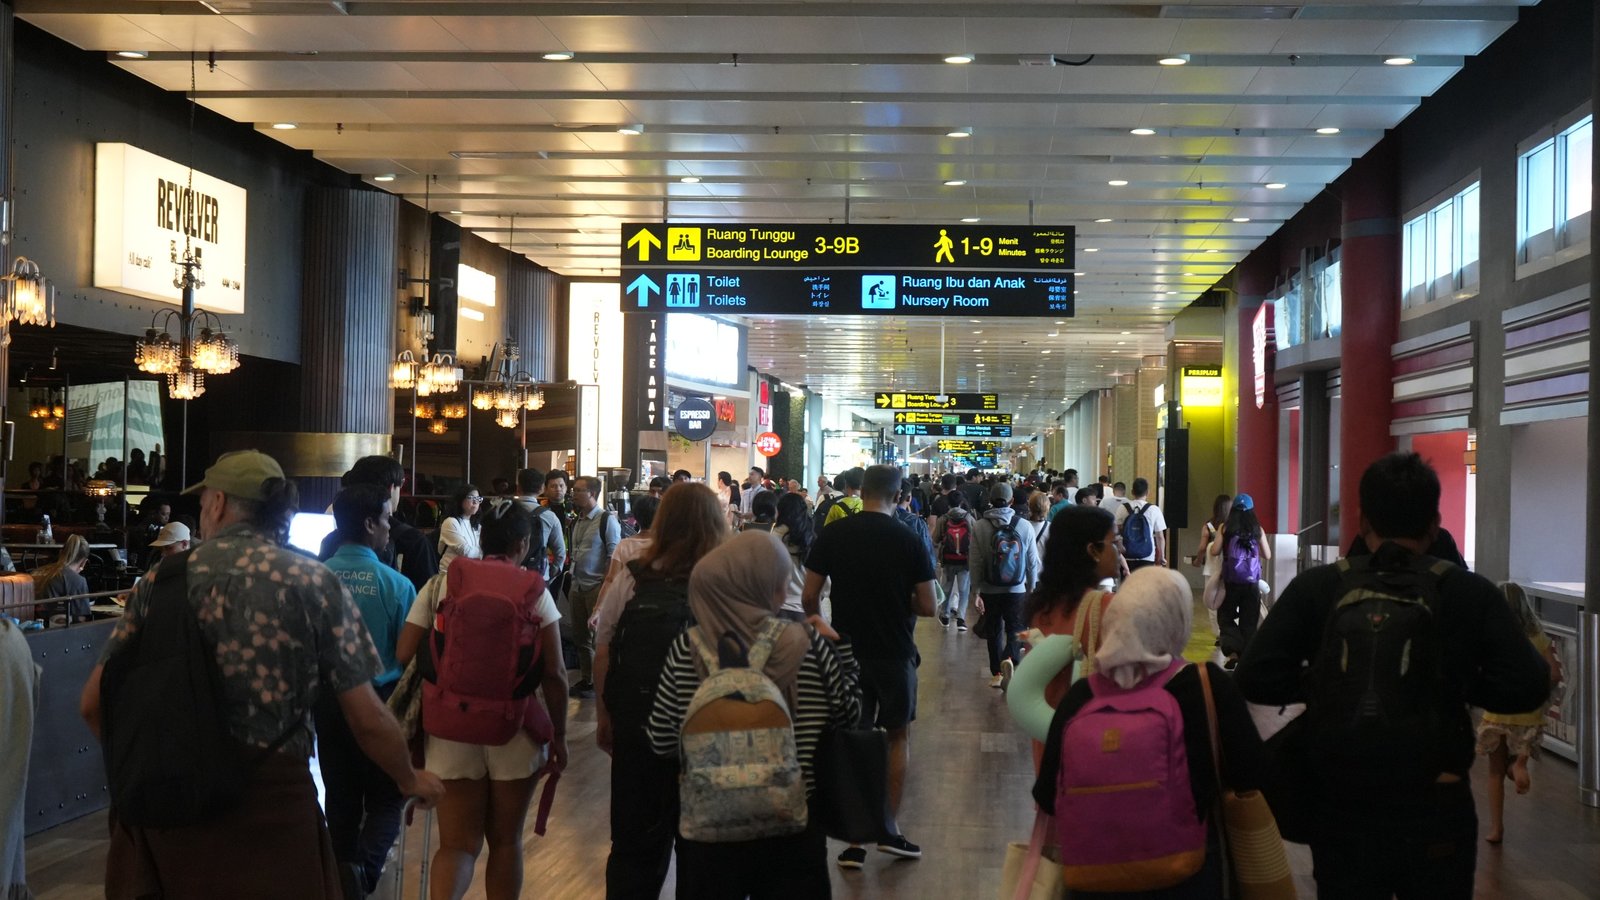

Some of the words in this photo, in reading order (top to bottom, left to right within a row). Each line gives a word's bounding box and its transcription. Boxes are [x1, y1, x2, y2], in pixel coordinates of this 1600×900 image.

[157, 178, 219, 245] REVOLVER
[707, 228, 747, 243] Ruang
[749, 228, 796, 243] Tunggu
[998, 237, 1019, 245] Menit
[814, 236, 860, 254] 3-9B
[960, 237, 994, 256] 1-9
[998, 248, 1027, 257] Minutes
[706, 246, 761, 262] Boarding
[763, 247, 809, 262] Lounge
[706, 275, 740, 288] Toilet
[902, 275, 943, 291] Ruang
[945, 276, 965, 288] Ibu
[970, 276, 991, 289] dan
[993, 276, 1026, 289] Anak
[706, 294, 747, 306] Toilets
[902, 294, 950, 309] Nursery
[953, 294, 989, 307] Room
[649, 319, 657, 369] TAKE
[648, 375, 657, 425] AWAY
[907, 394, 924, 402] Ruang
[950, 398, 957, 406] 3
[679, 409, 711, 420] ESPRESSO
[688, 420, 702, 430] BAR
